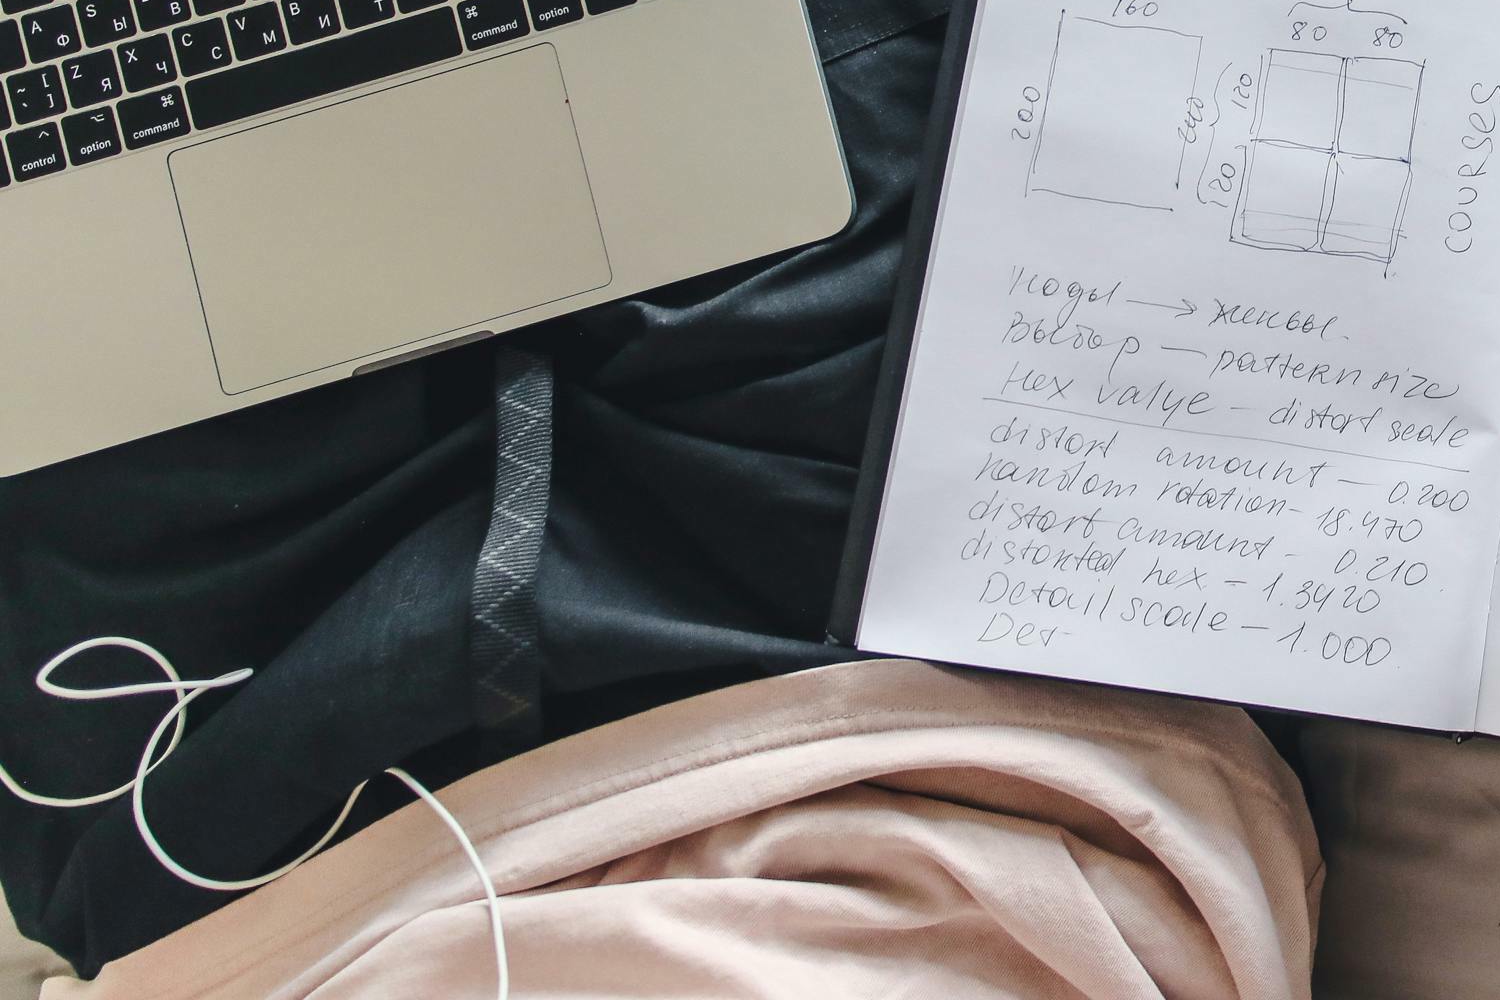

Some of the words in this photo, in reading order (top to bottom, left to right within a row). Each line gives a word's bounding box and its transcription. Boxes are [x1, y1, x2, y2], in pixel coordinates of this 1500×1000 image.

[86, 4, 96, 17] S
[170, 2, 181, 15] В
[290, 3, 300, 15] B
[374, 0, 383, 11] Т
[539, 7, 569, 20] option
[32, 21, 42, 34] A
[113, 17, 127, 31] Ы
[235, 17, 245, 30] V
[319, 15, 330, 28] И
[472, 20, 517, 40] command
[1292, 21, 1327, 41] 80
[1373, 26, 1403, 48] 80
[57, 34, 69, 46] Ф
[182, 34, 192, 46] C
[263, 30, 276, 44] М
[126, 49, 137, 63] X
[212, 47, 222, 59] С
[71, 65, 82, 79] Z
[156, 61, 167, 73] Ч
[102, 78, 111, 91] Я
[1232, 73, 1252, 109] 120
[1011, 86, 1040, 139] 200
[133, 118, 179, 139] command
[81, 140, 111, 154] option
[22, 154, 56, 171] control
